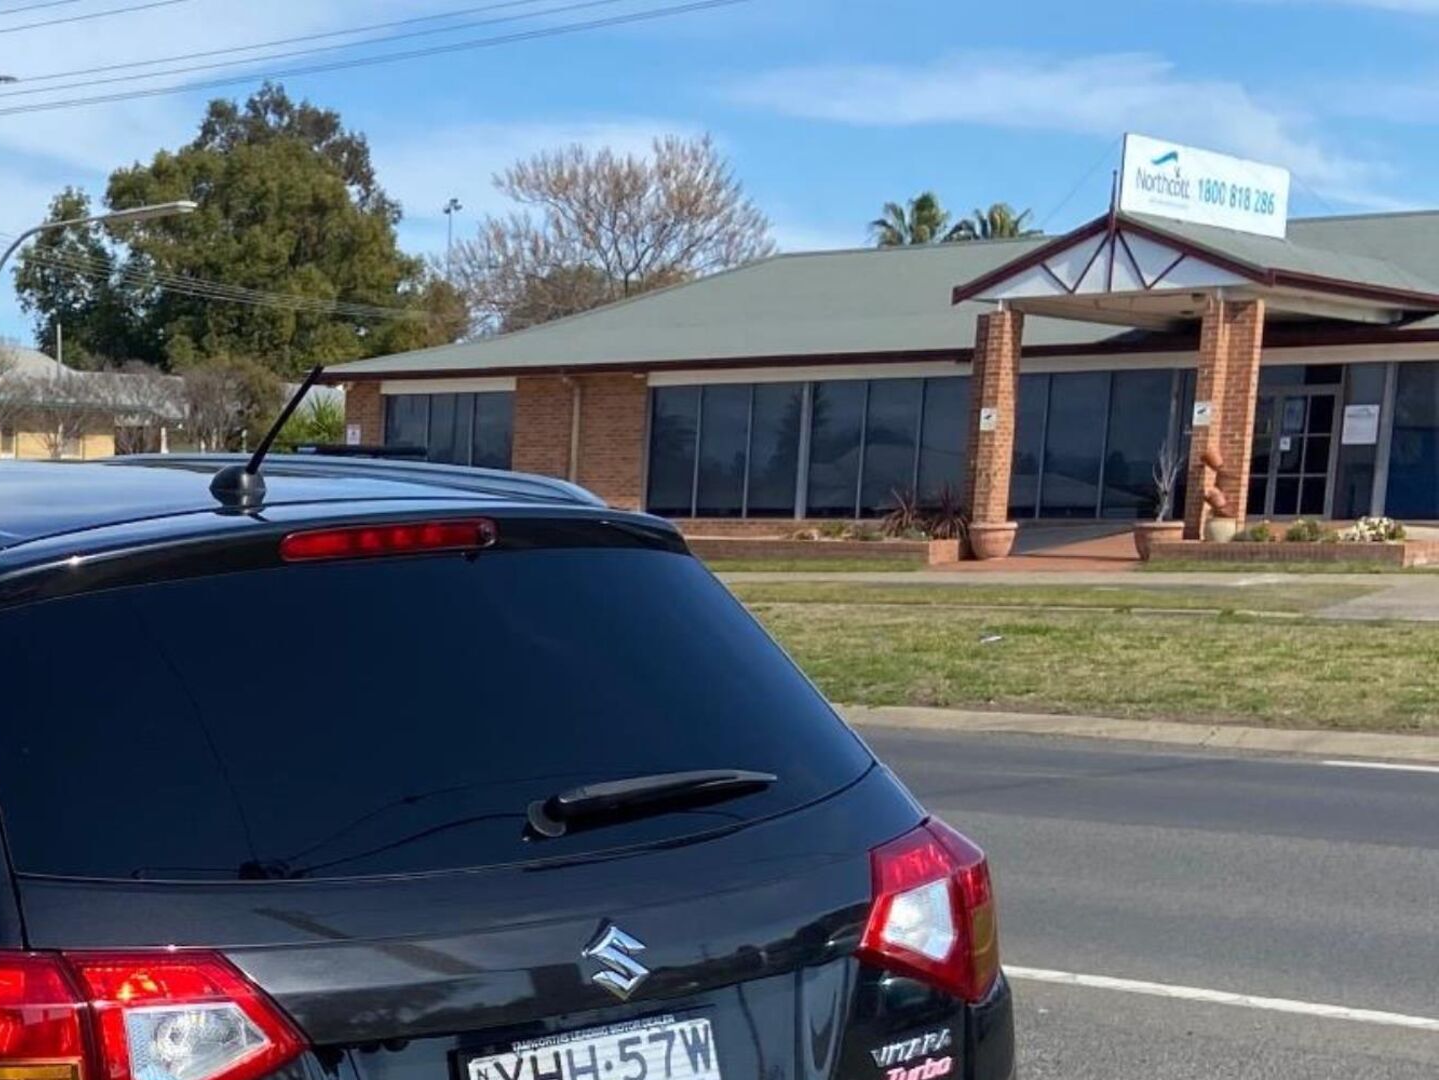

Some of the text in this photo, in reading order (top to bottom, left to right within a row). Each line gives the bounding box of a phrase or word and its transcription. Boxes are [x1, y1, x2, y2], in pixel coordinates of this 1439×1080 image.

[1136, 167, 1190, 199] Northcott
[1198, 178, 1276, 216] 1800 818 286
